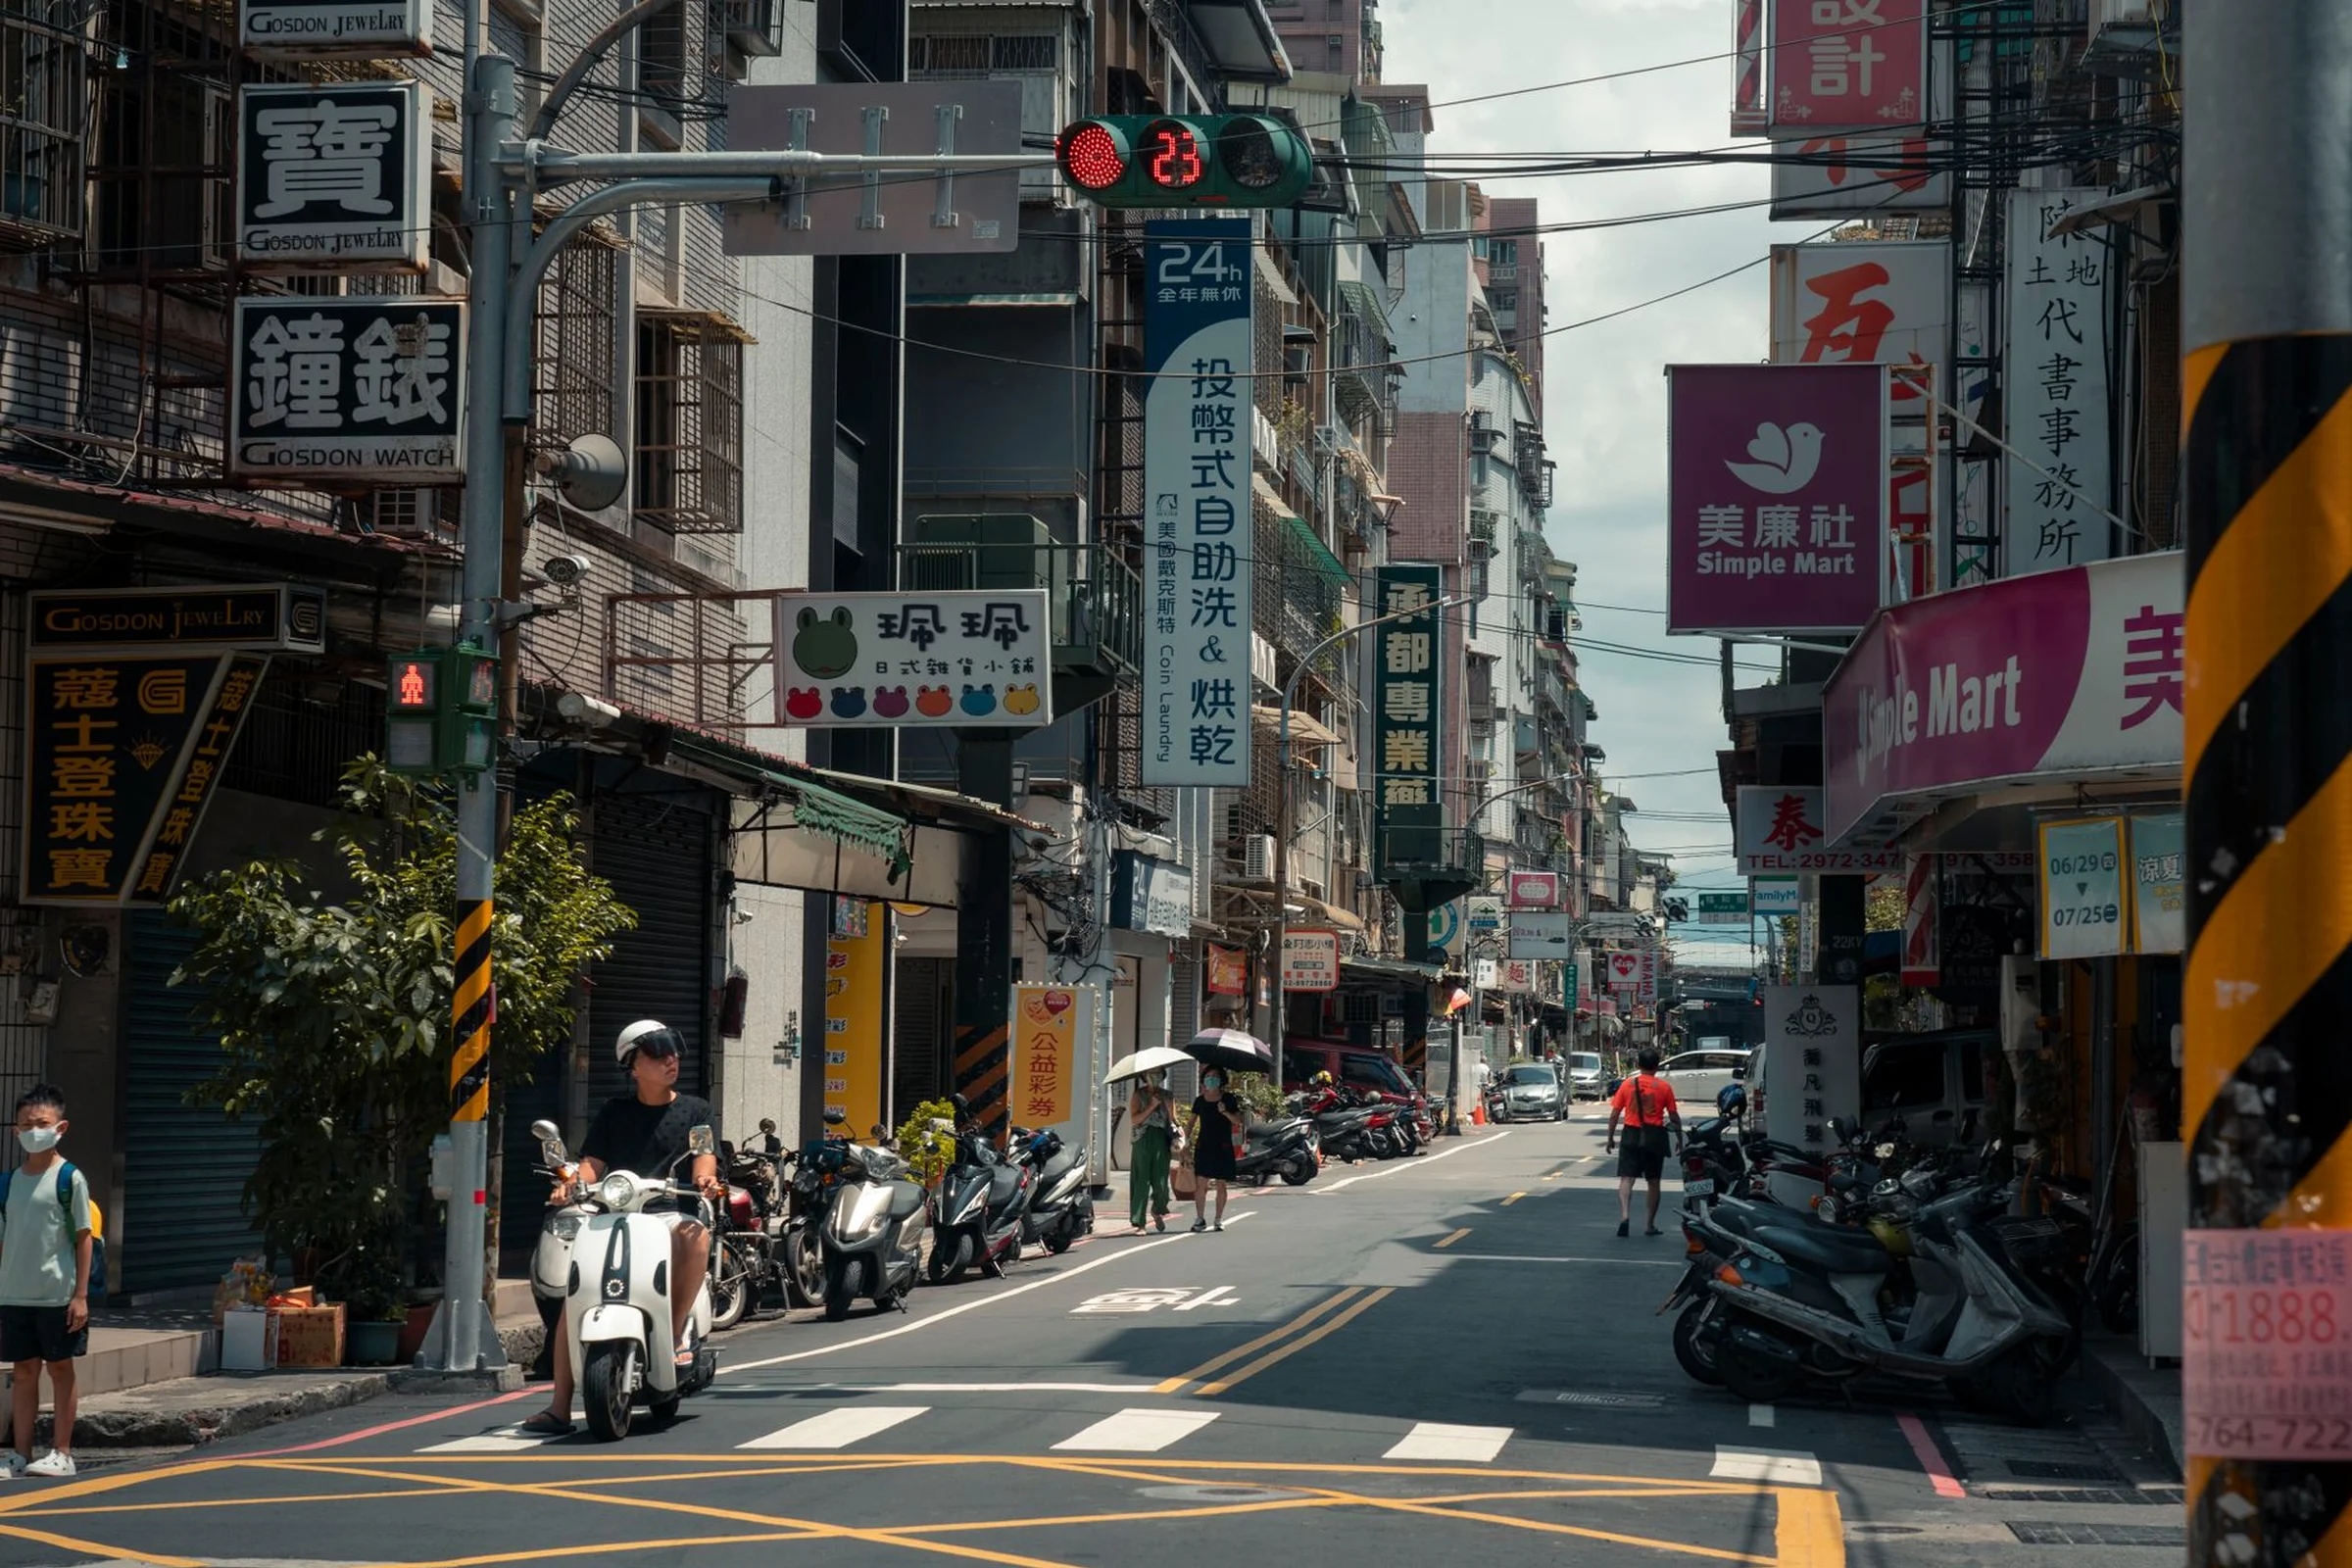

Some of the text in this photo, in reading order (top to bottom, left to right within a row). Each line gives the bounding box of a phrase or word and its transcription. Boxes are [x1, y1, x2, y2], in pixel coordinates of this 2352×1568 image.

[248, 9, 406, 37] GOSDON JEWELRY
[254, 99, 397, 219] 寶
[1153, 131, 1200, 182] 23
[246, 225, 403, 255] GOSDON JEWELRY
[1158, 241, 1243, 283] 24h
[1157, 287, 1242, 303] 全年無休
[249, 312, 451, 428] 鐘錶
[240, 442, 455, 467] GOSDON WATCH
[1697, 504, 1855, 549] 美廉社
[1696, 552, 1855, 580] Simple Mart
[45, 608, 164, 632] GOSDON
[878, 602, 1030, 652] 珮珮
[1159, 645, 1175, 685] Coin
[1927, 655, 2022, 739] Mart
[1156, 692, 1173, 763] Laundry
[48, 668, 120, 889] 蔻士登珠寶
[1762, 793, 1825, 852] 泰
[1746, 853, 1905, 868] TEL:2972-347
[2050, 854, 2098, 875] 06/29
[1753, 890, 1797, 902] amilyM
[2054, 906, 2102, 927] 07/25
[1026, 1032, 1058, 1117] 公益彩券
